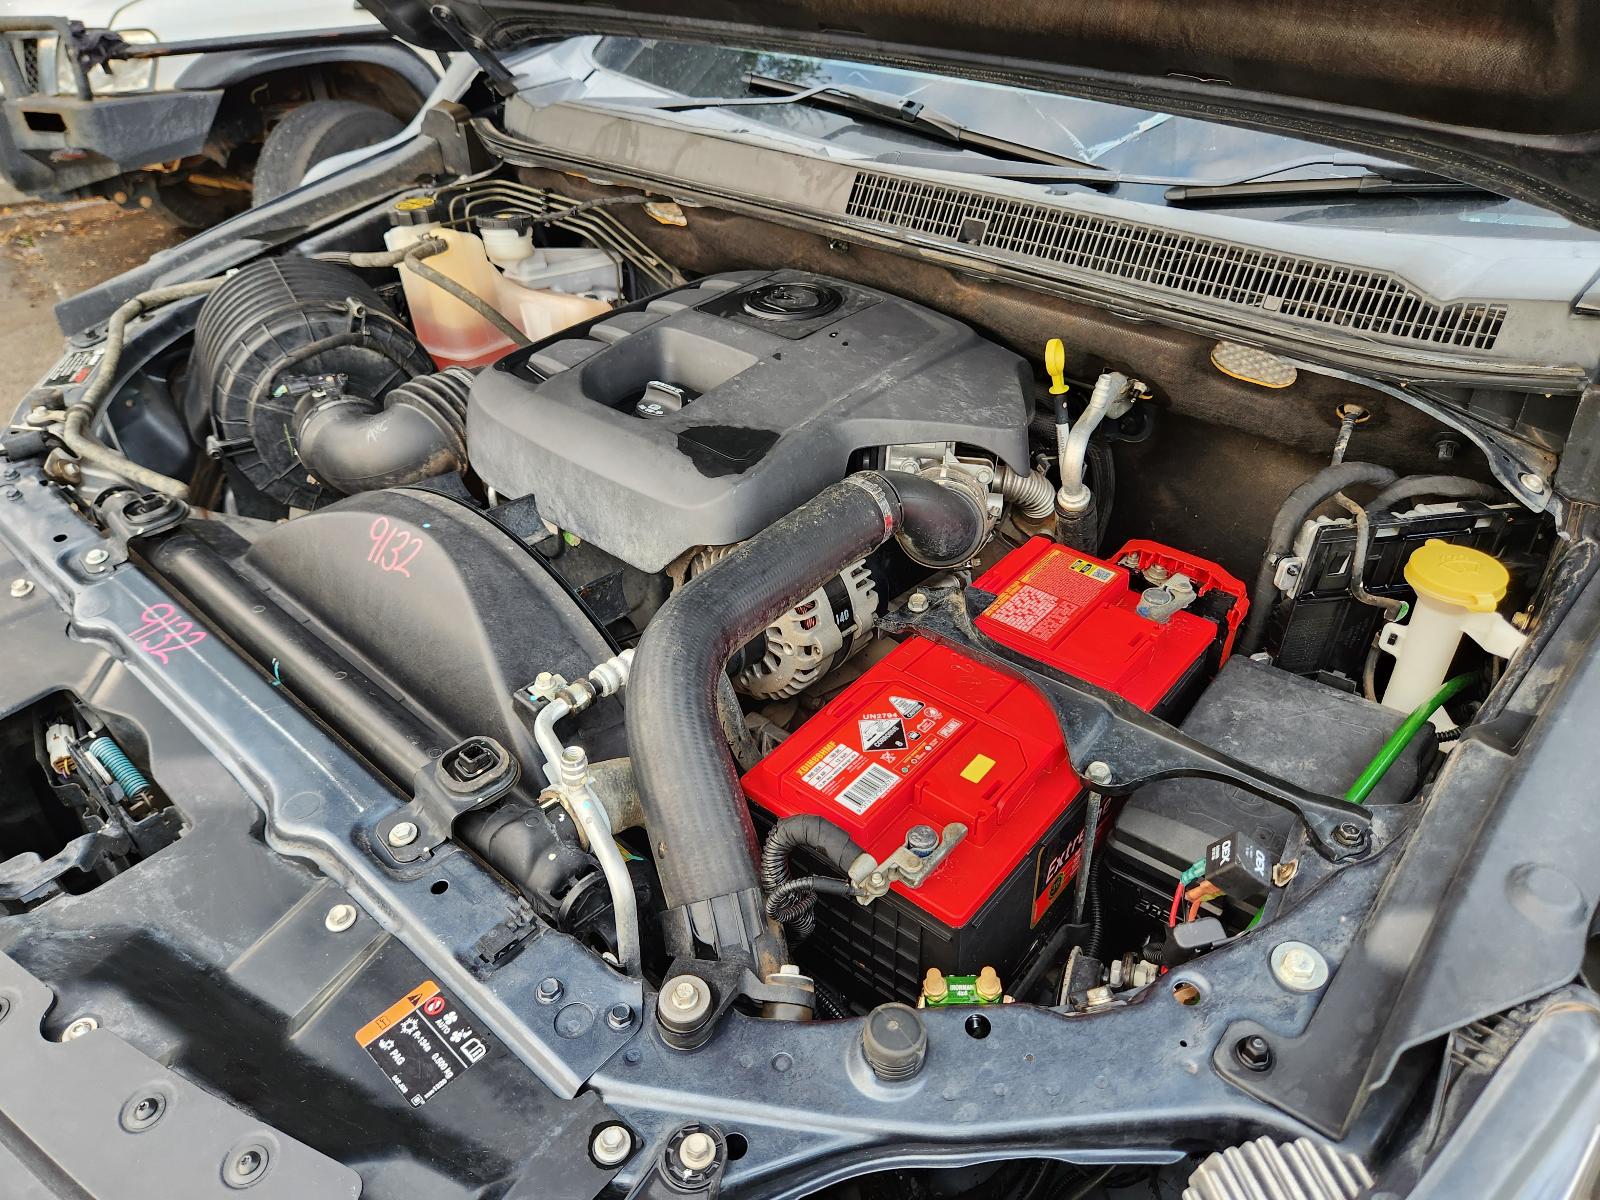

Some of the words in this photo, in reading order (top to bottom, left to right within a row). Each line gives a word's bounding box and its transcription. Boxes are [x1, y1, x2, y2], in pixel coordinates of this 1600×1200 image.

[367, 516, 422, 578] 9132
[836, 609, 850, 625] 140
[128, 603, 207, 664] 9132
[862, 712, 898, 720] UN2794
[873, 725, 900, 747] CORROSIVE
[1219, 839, 1232, 866] OEX
[1254, 849, 1266, 878] OEX
[434, 1018, 451, 1035] AUTO
[389, 1048, 406, 1066] PAG
[412, 1030, 432, 1053] R-134a
[431, 1052, 448, 1073] 0.500
[443, 1066, 454, 1080] kg
